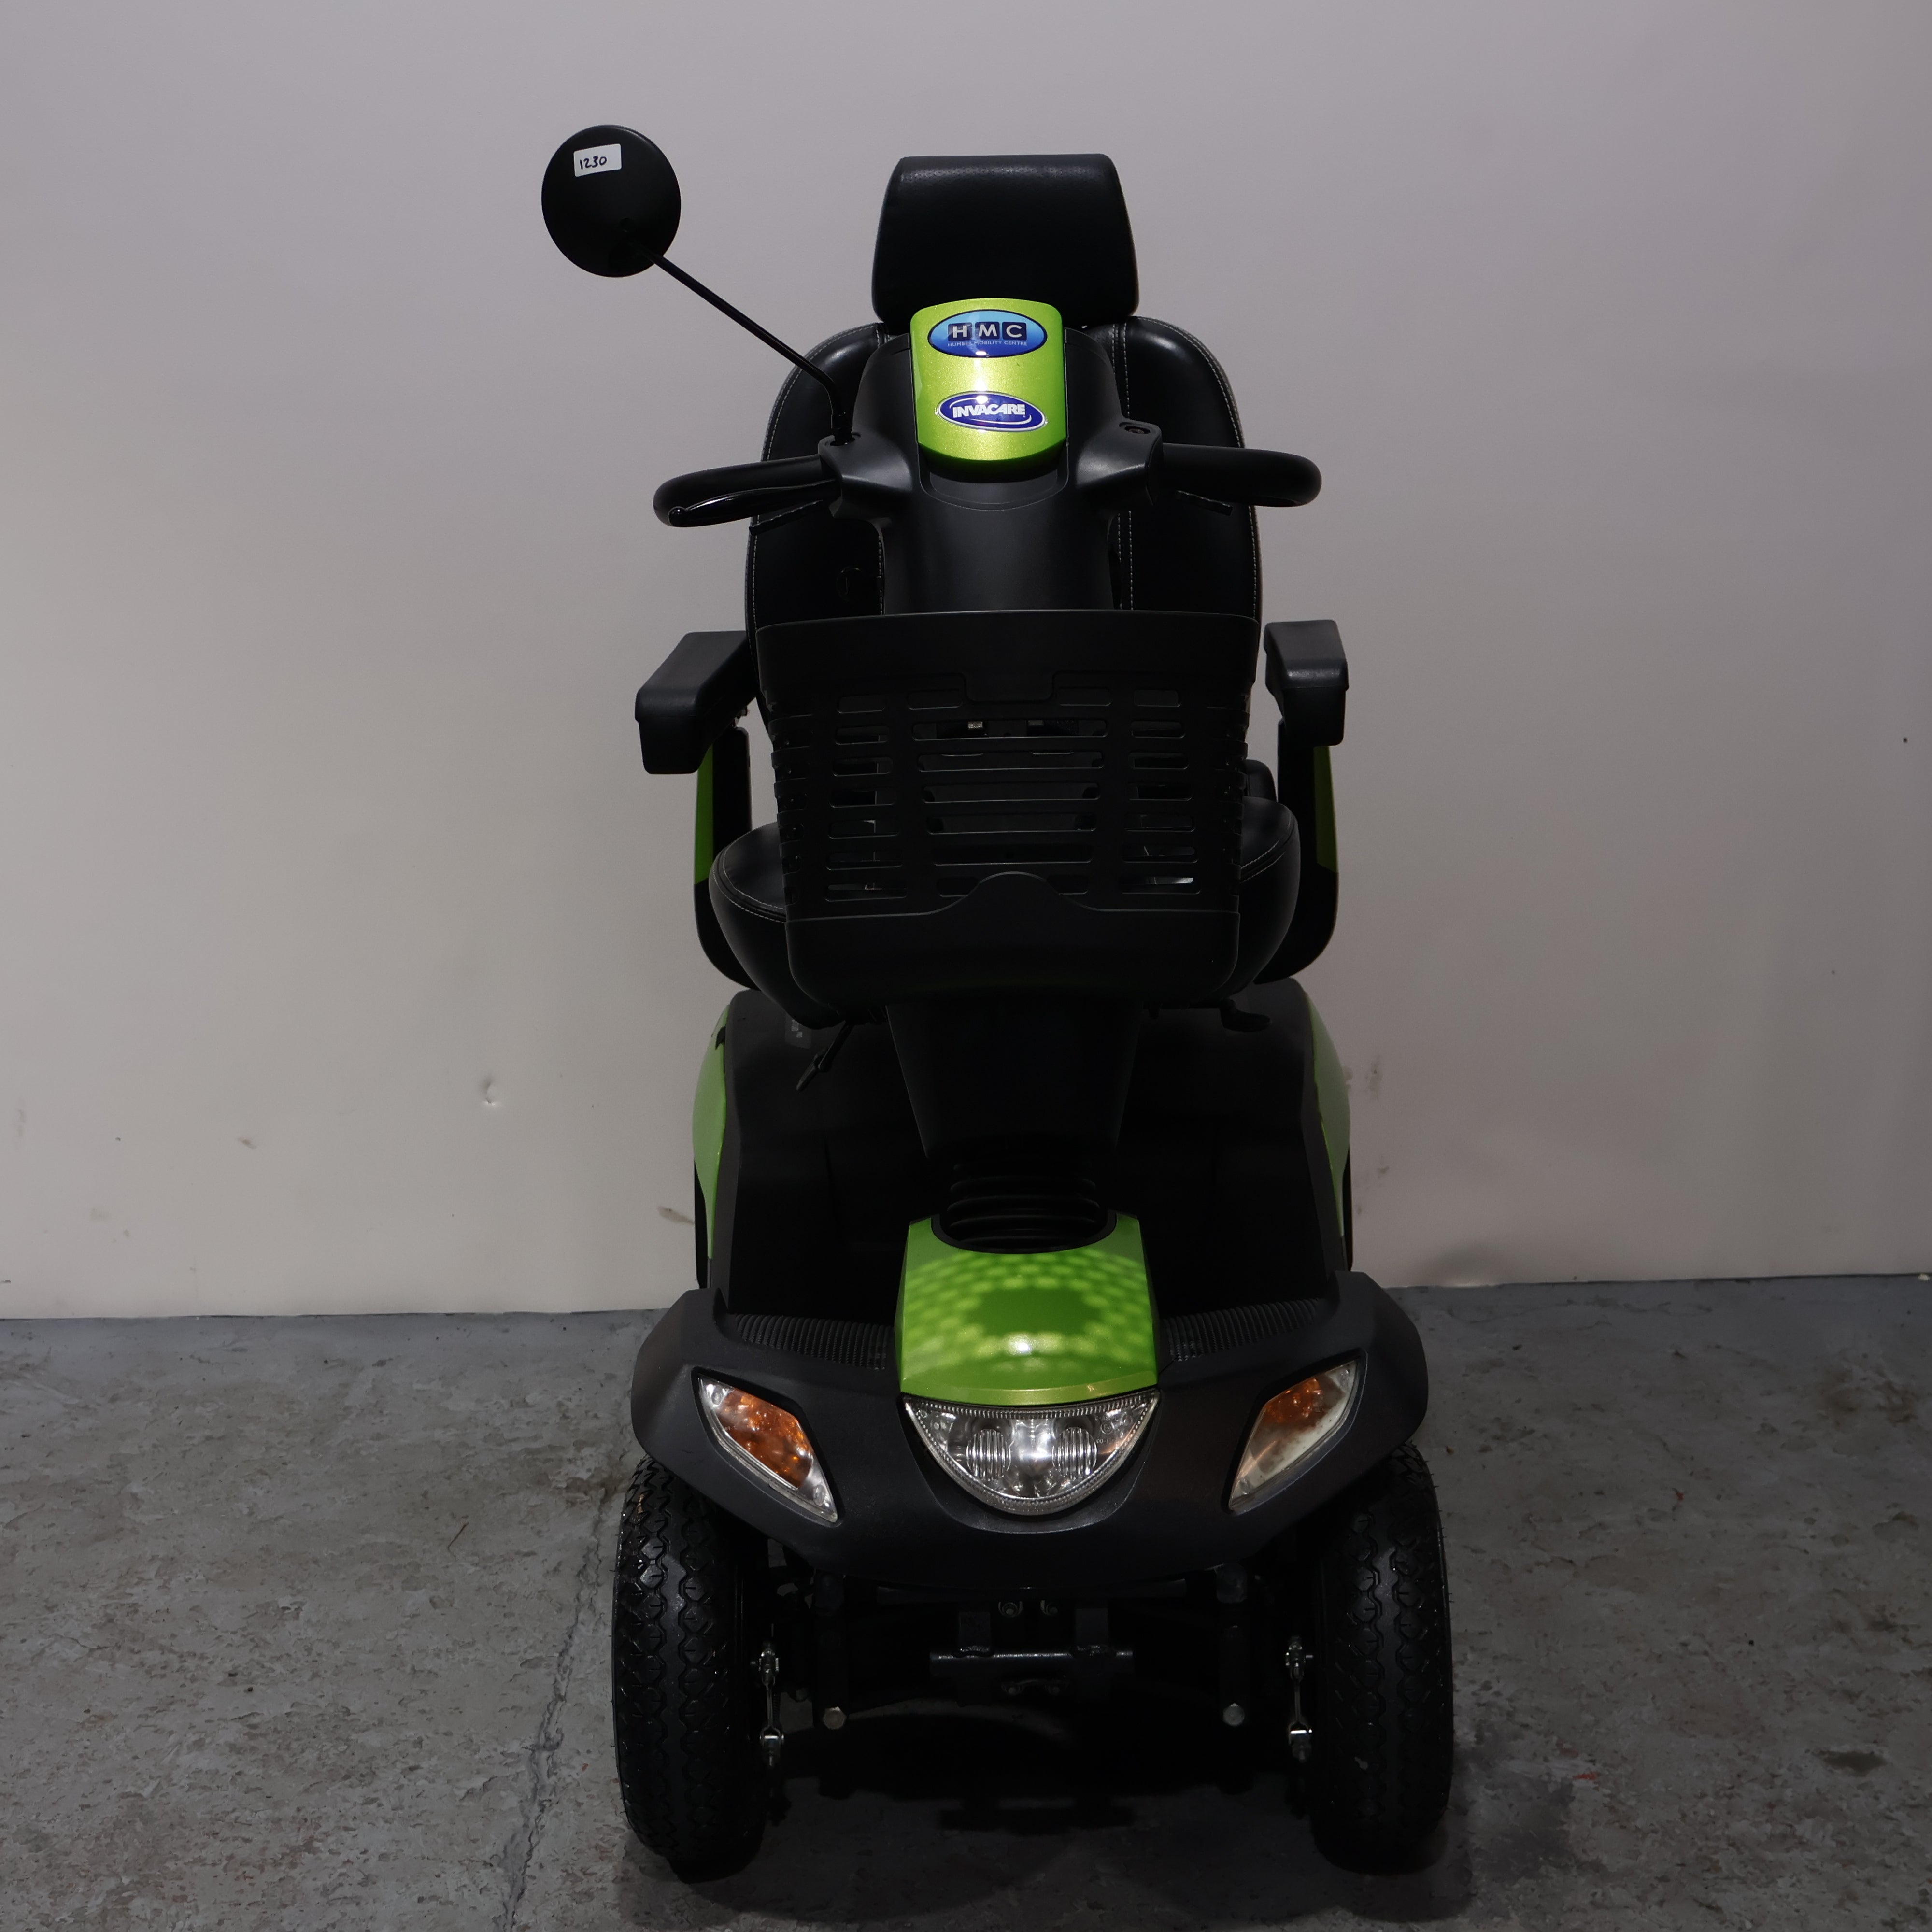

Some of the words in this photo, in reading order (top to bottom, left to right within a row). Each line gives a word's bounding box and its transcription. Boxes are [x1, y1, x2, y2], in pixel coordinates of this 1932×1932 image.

[580, 156, 607, 169] 1230
[952, 324, 1022, 338] HMC
[952, 404, 1025, 418] INVACARE
